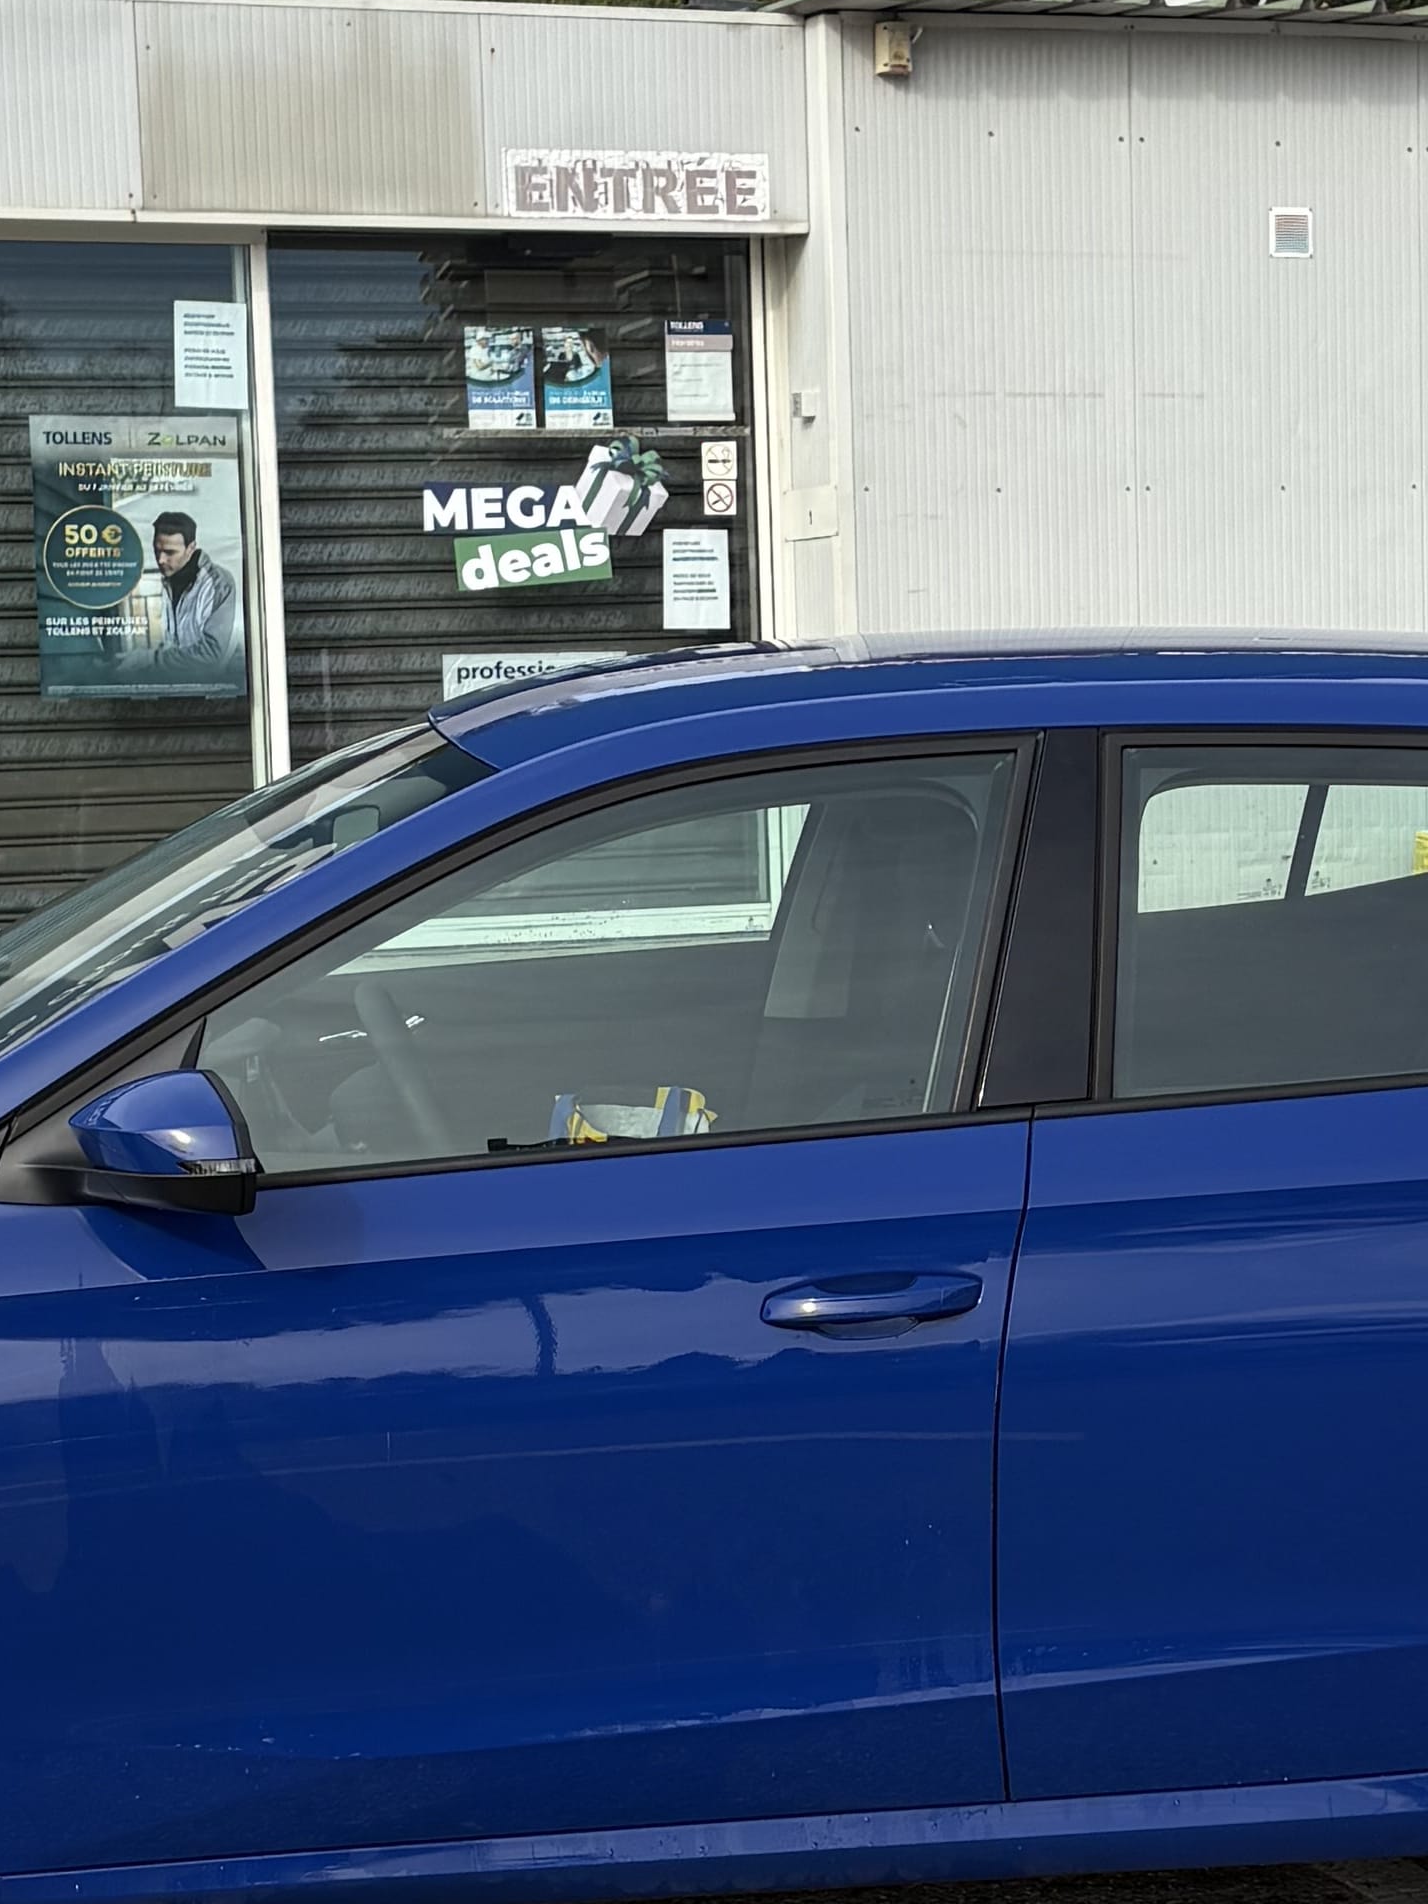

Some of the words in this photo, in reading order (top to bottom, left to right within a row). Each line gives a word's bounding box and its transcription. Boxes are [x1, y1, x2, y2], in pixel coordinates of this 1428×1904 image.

[42, 431, 113, 446] TOLLENS
[58, 461, 130, 478] INSTANT
[423, 485, 593, 532] MEGA
[64, 524, 98, 545] 50
[101, 524, 123, 545] €
[461, 528, 611, 591] deals
